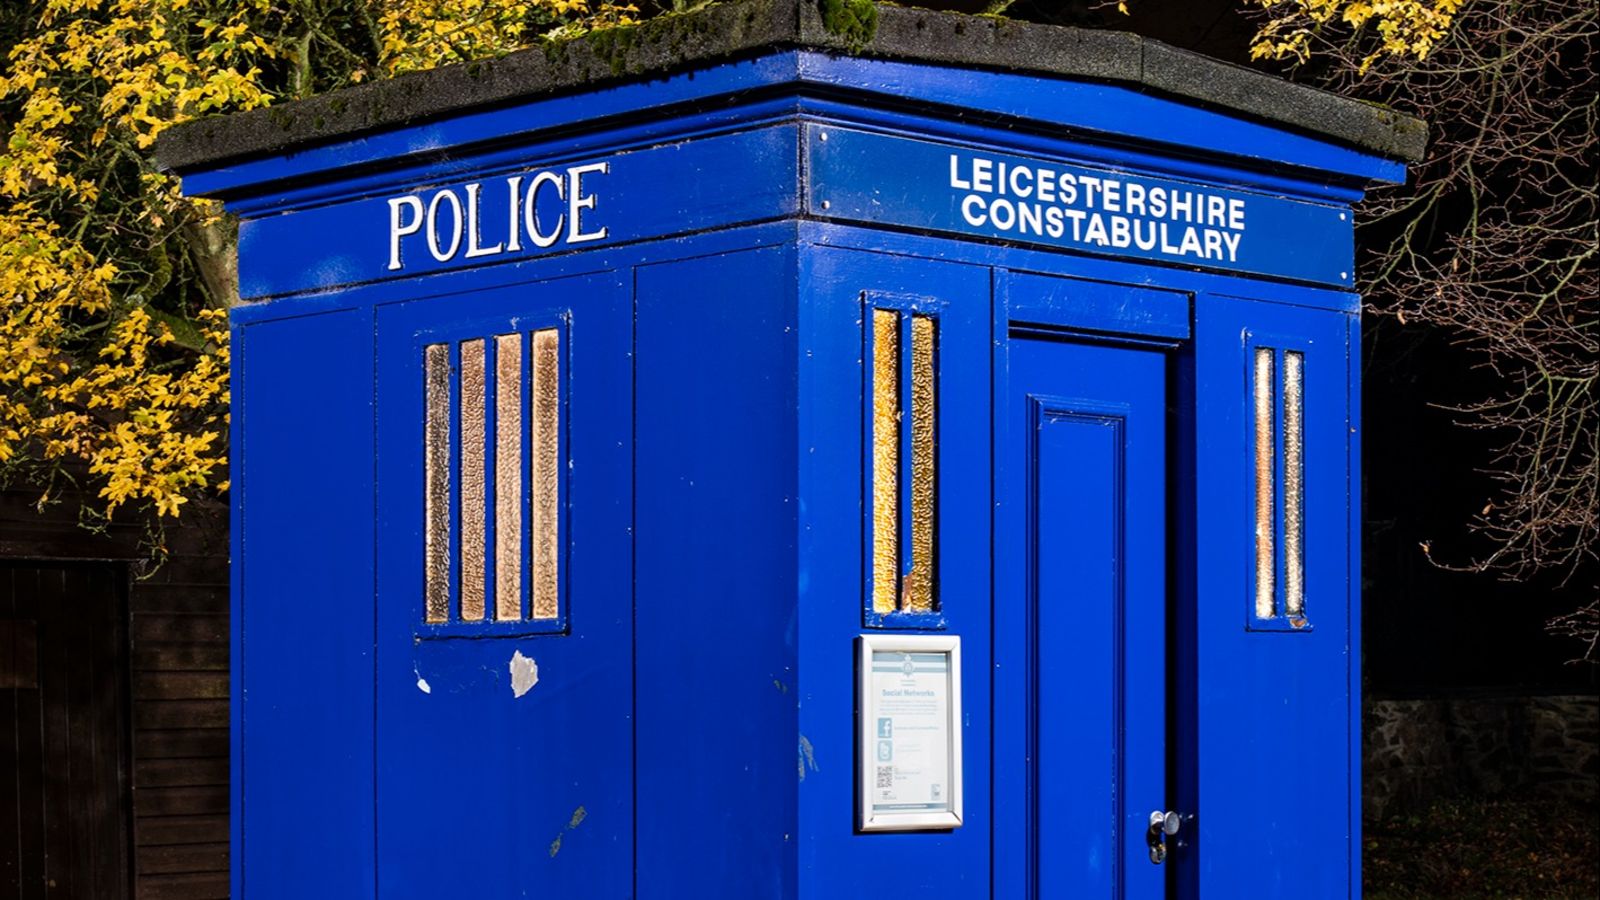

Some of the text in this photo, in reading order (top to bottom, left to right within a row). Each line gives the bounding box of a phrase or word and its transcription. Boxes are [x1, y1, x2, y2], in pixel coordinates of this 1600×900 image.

[387, 161, 609, 270] POLICE
[950, 154, 1245, 231] LEICESTERSHIRE
[961, 194, 1242, 262] CONSTABULARY
[882, 688, 935, 697] Social Networks
